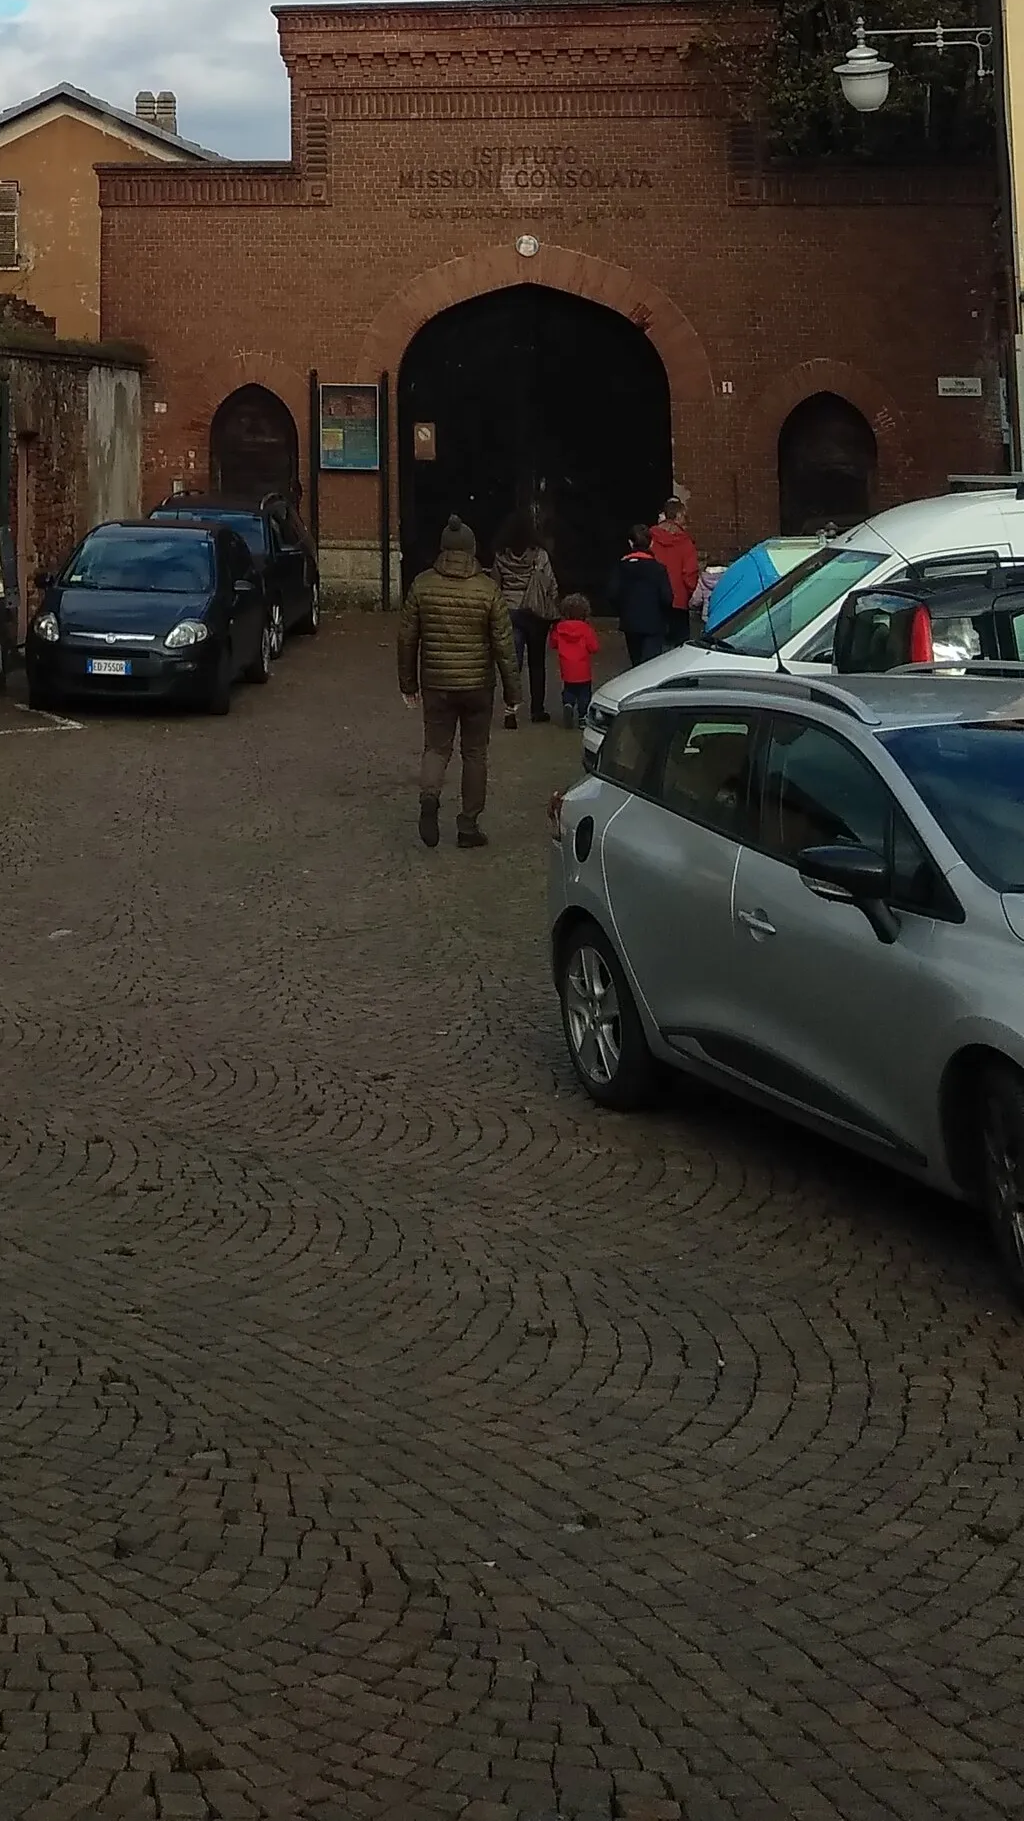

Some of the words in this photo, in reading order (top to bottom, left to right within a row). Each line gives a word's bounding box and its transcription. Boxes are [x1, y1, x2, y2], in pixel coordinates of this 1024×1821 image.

[472, 146, 579, 165] ISTITUTO
[398, 169, 502, 189] MISSIONI
[514, 169, 653, 189] CONSOLATA
